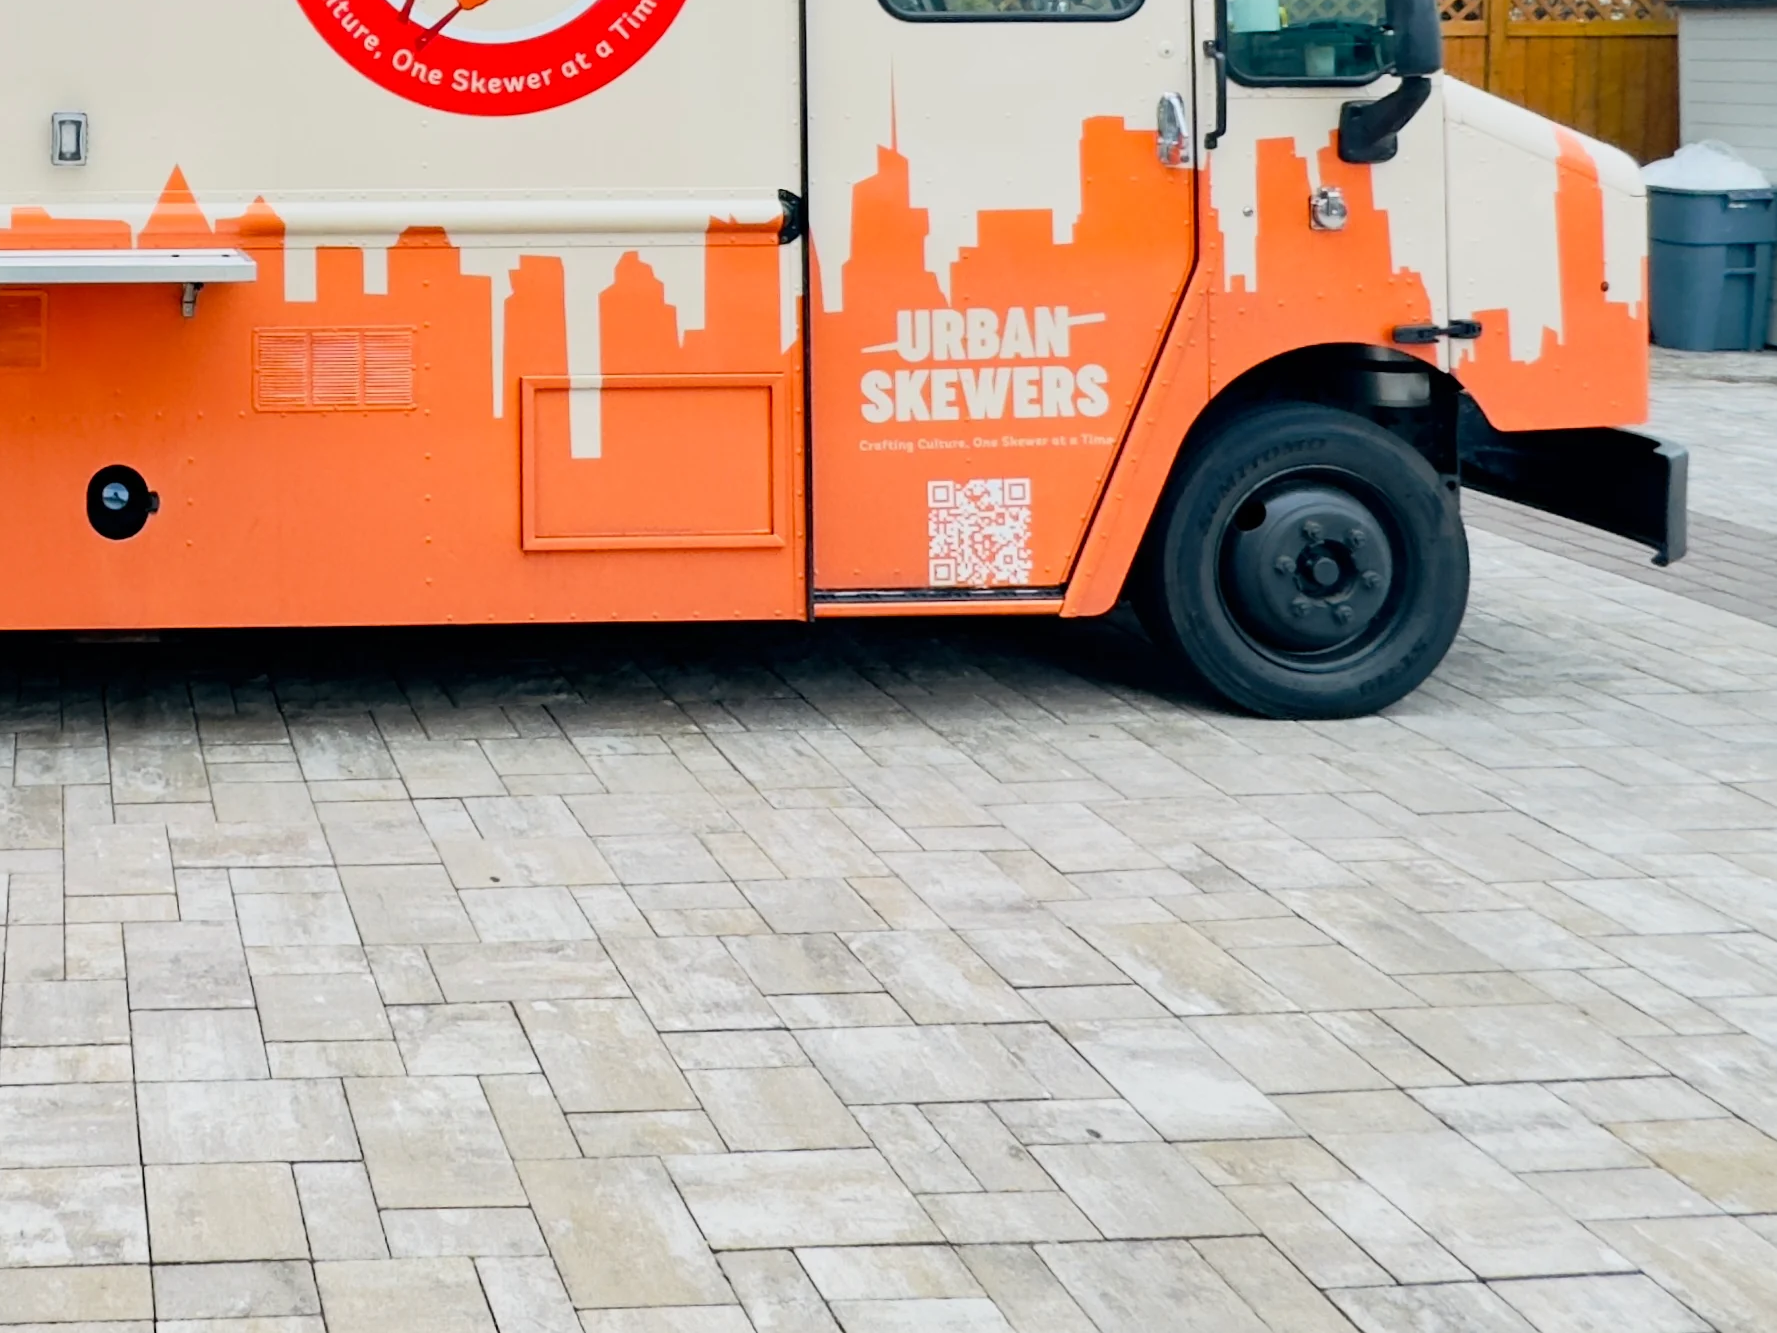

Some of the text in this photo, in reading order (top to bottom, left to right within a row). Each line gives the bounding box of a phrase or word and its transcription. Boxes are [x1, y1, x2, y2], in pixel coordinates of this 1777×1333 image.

[392, 48, 443, 86] One
[452, 68, 552, 94] Skewer
[561, 51, 591, 79] at
[595, 39, 613, 59] a
[896, 306, 1071, 363] URBAN
[860, 364, 1110, 424] SKEWERS
[859, 439, 914, 453] Crafting
[973, 437, 998, 448] One
[1001, 436, 1048, 447] Skewer
[1052, 435, 1067, 445] at
[1069, 437, 1078, 445] a
